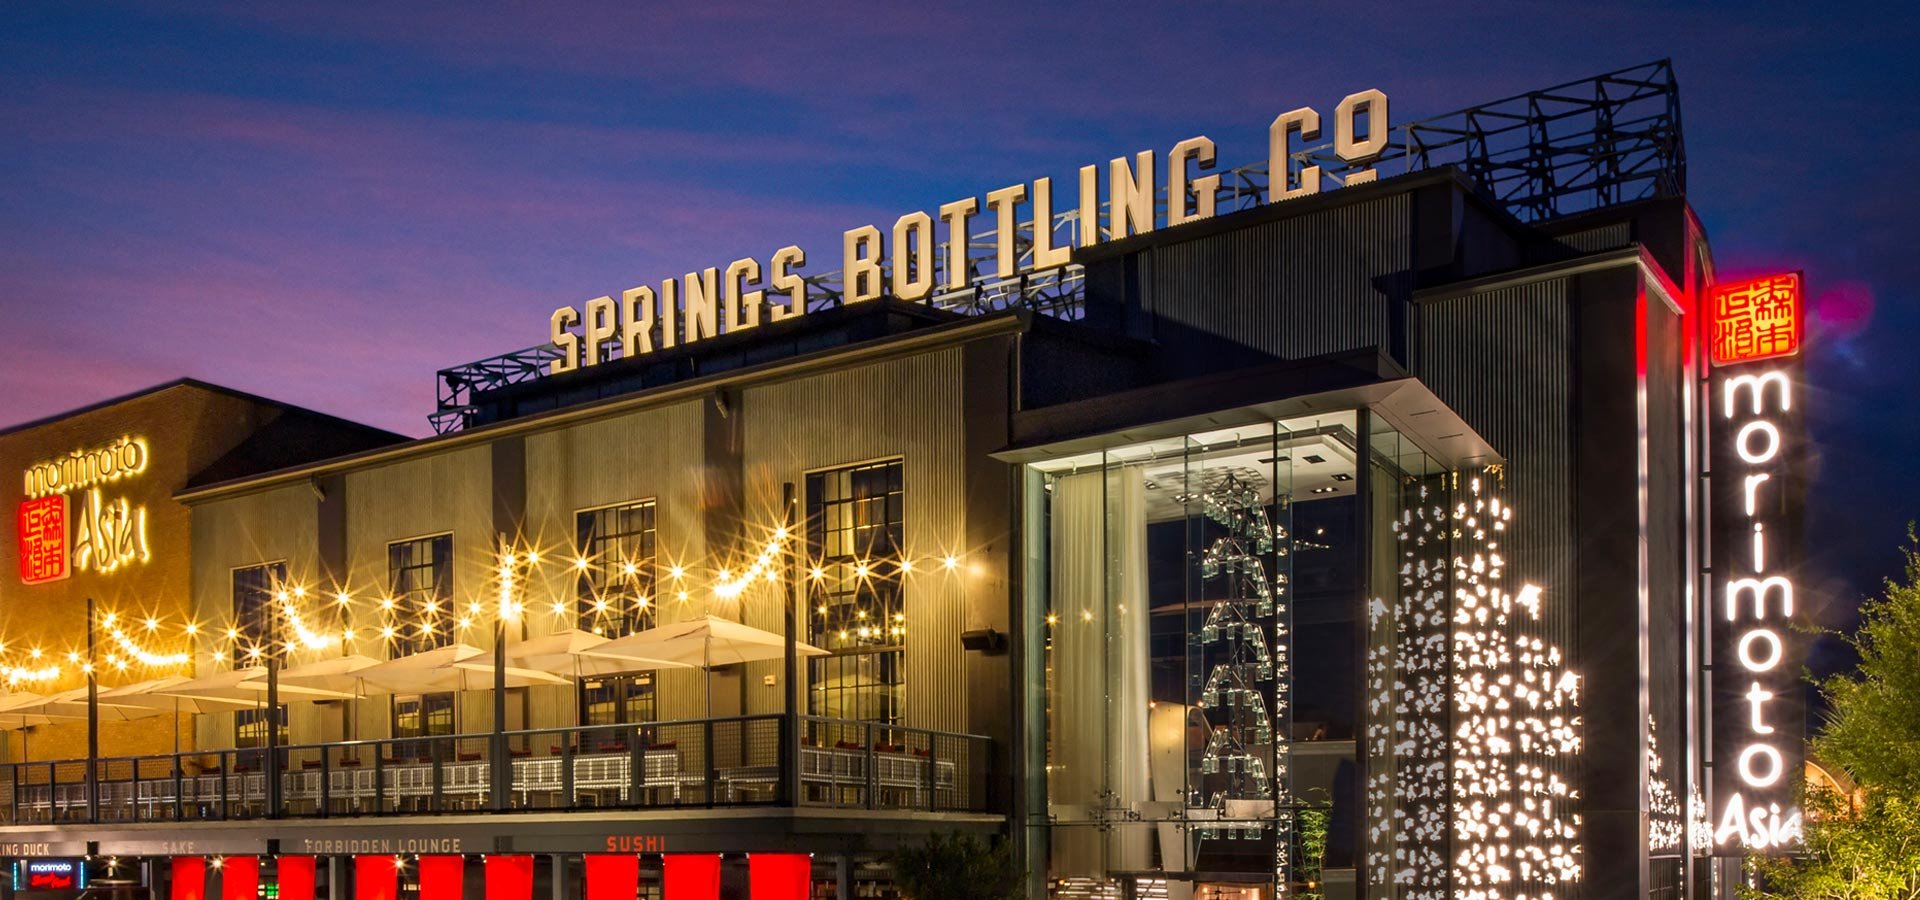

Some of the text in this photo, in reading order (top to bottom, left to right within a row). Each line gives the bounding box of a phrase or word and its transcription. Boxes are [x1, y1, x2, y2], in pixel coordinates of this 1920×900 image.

[550, 245, 806, 375] SPRINGS
[843, 135, 1221, 306] BOTTLING
[24, 437, 147, 499] morimoto
[72, 487, 150, 572] Asia
[1724, 371, 1793, 788] morimoto
[1714, 792, 1803, 849] Asia
[0, 844, 50, 856] ING DUCK
[162, 842, 194, 854] SAKE
[306, 838, 461, 853] FORBIDDEN LOUNGE
[607, 836, 665, 852] SUSHI
[31, 863, 72, 872] morimoto
